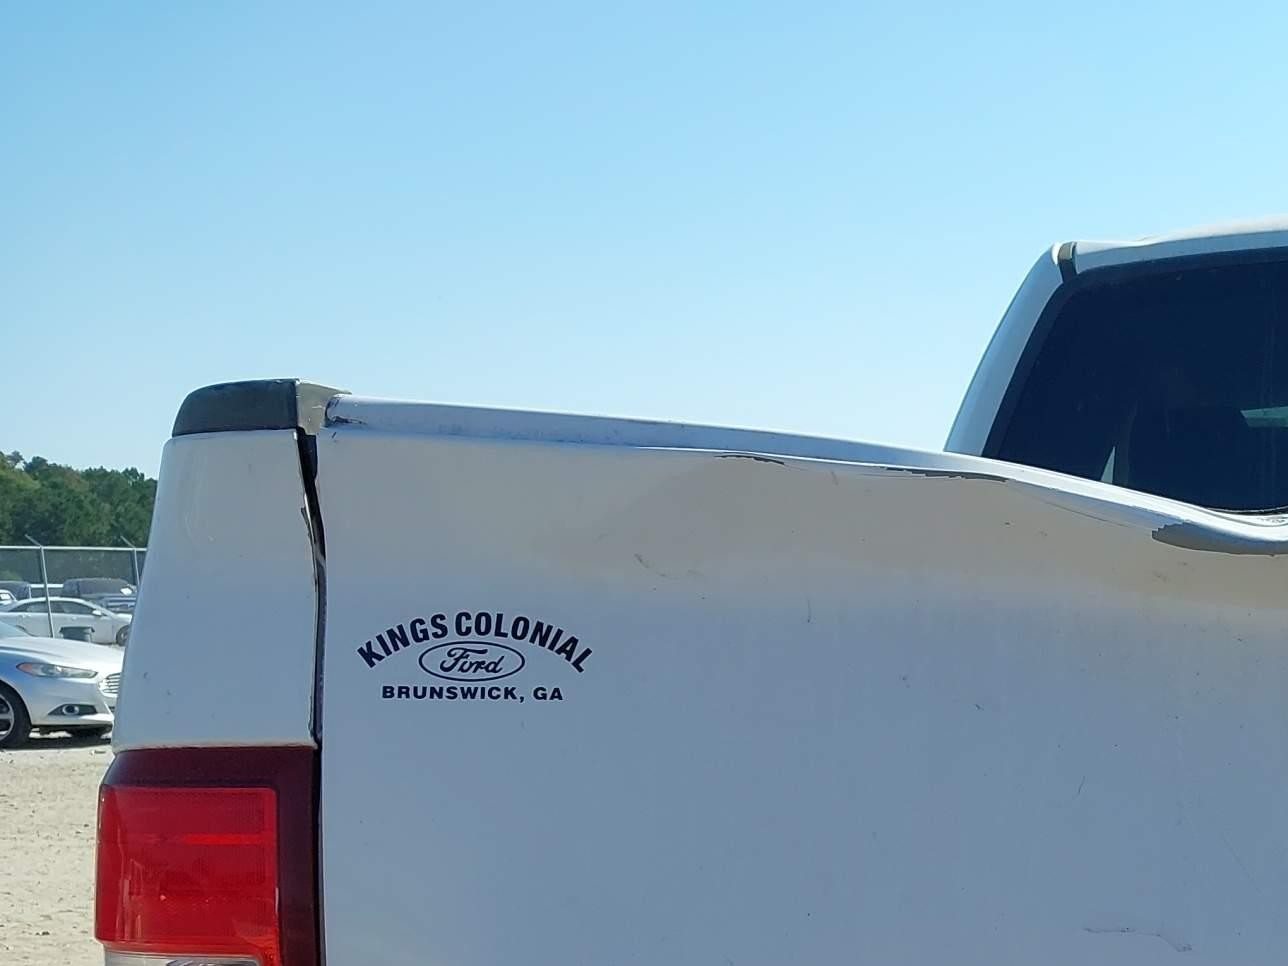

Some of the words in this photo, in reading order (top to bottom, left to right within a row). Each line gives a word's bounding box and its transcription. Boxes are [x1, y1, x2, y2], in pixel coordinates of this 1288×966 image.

[357, 613, 448, 668] KINGS
[455, 611, 593, 673] COLONIAL
[440, 647, 505, 673] Ford
[382, 685, 525, 703] BRUNSWICK,
[533, 687, 563, 700] GA
